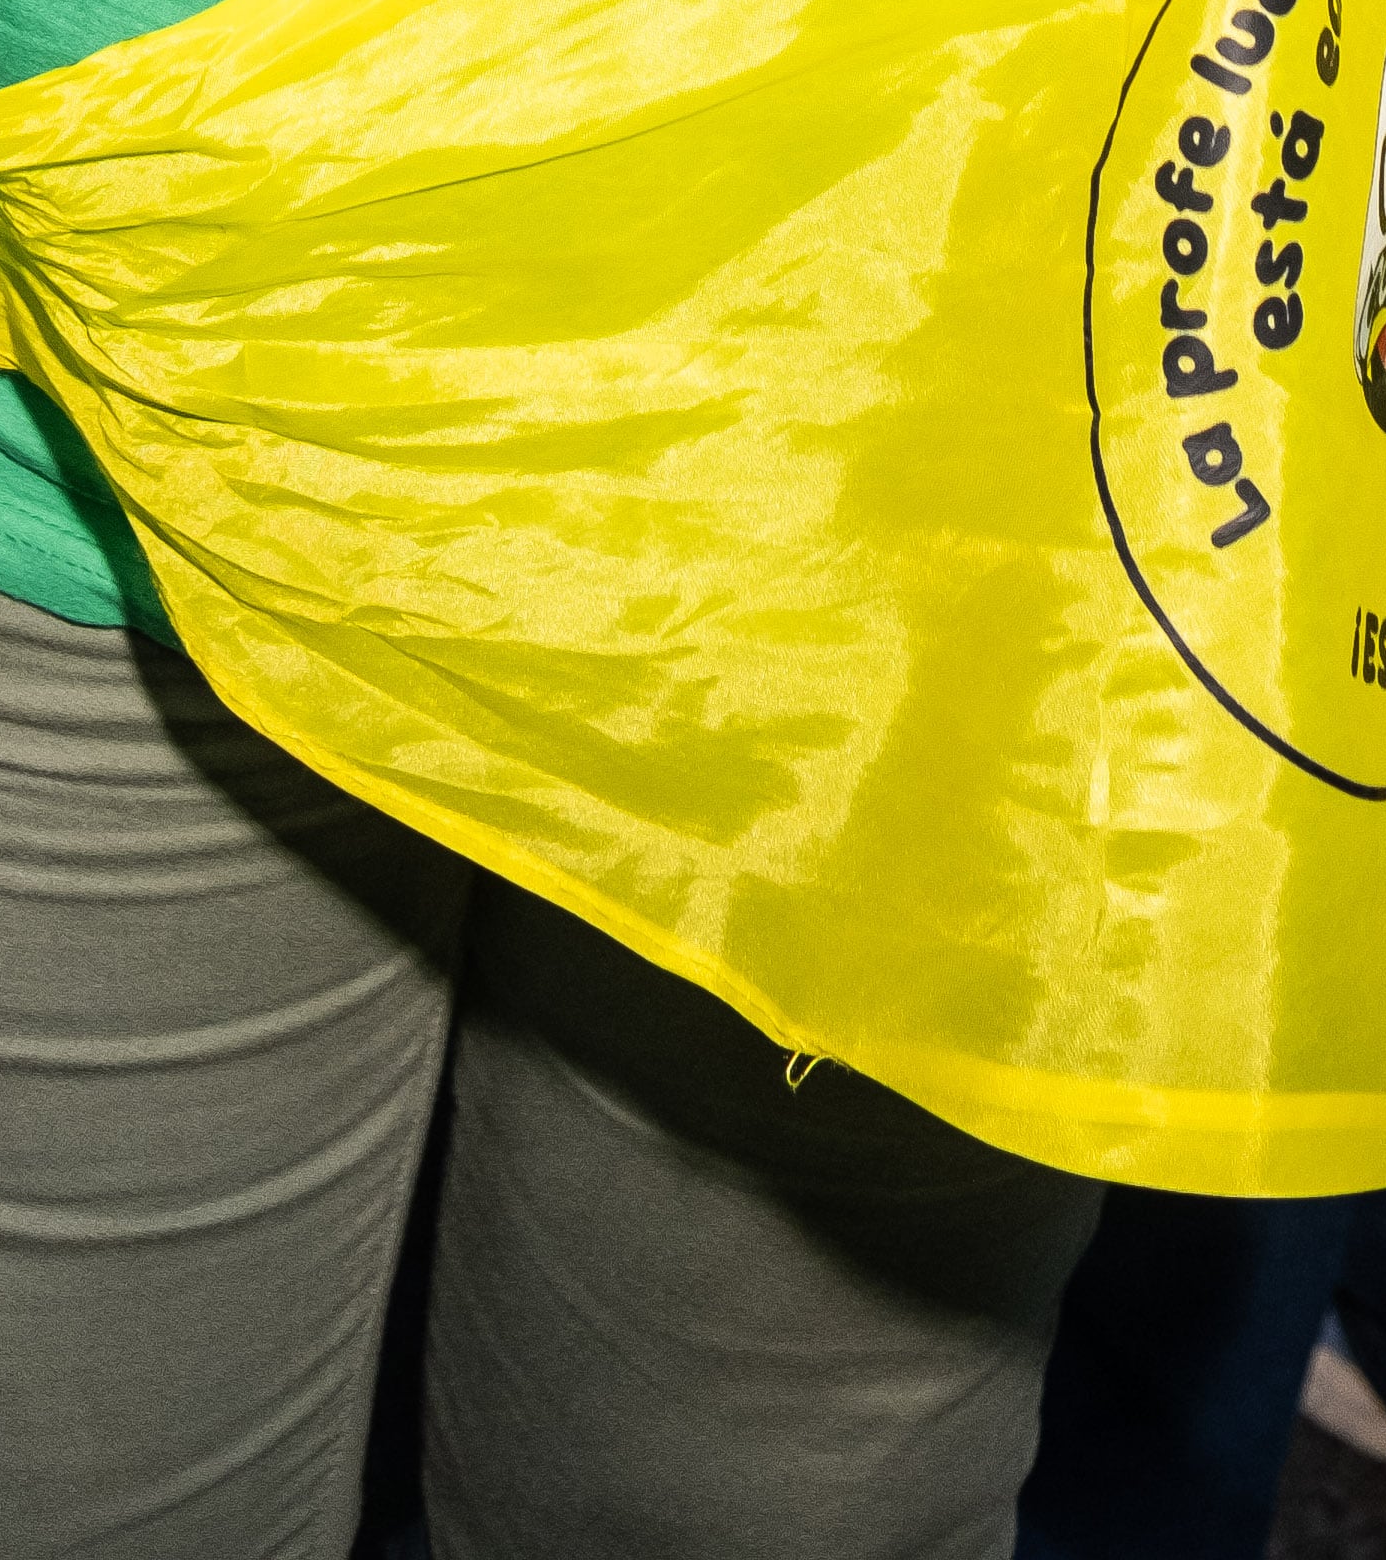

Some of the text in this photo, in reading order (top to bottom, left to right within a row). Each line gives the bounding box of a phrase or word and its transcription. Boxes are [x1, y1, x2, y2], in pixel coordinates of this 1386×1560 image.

[1154, 116, 1240, 399] profe
[1252, 109, 1326, 351] está
[1181, 421, 1271, 549] La
